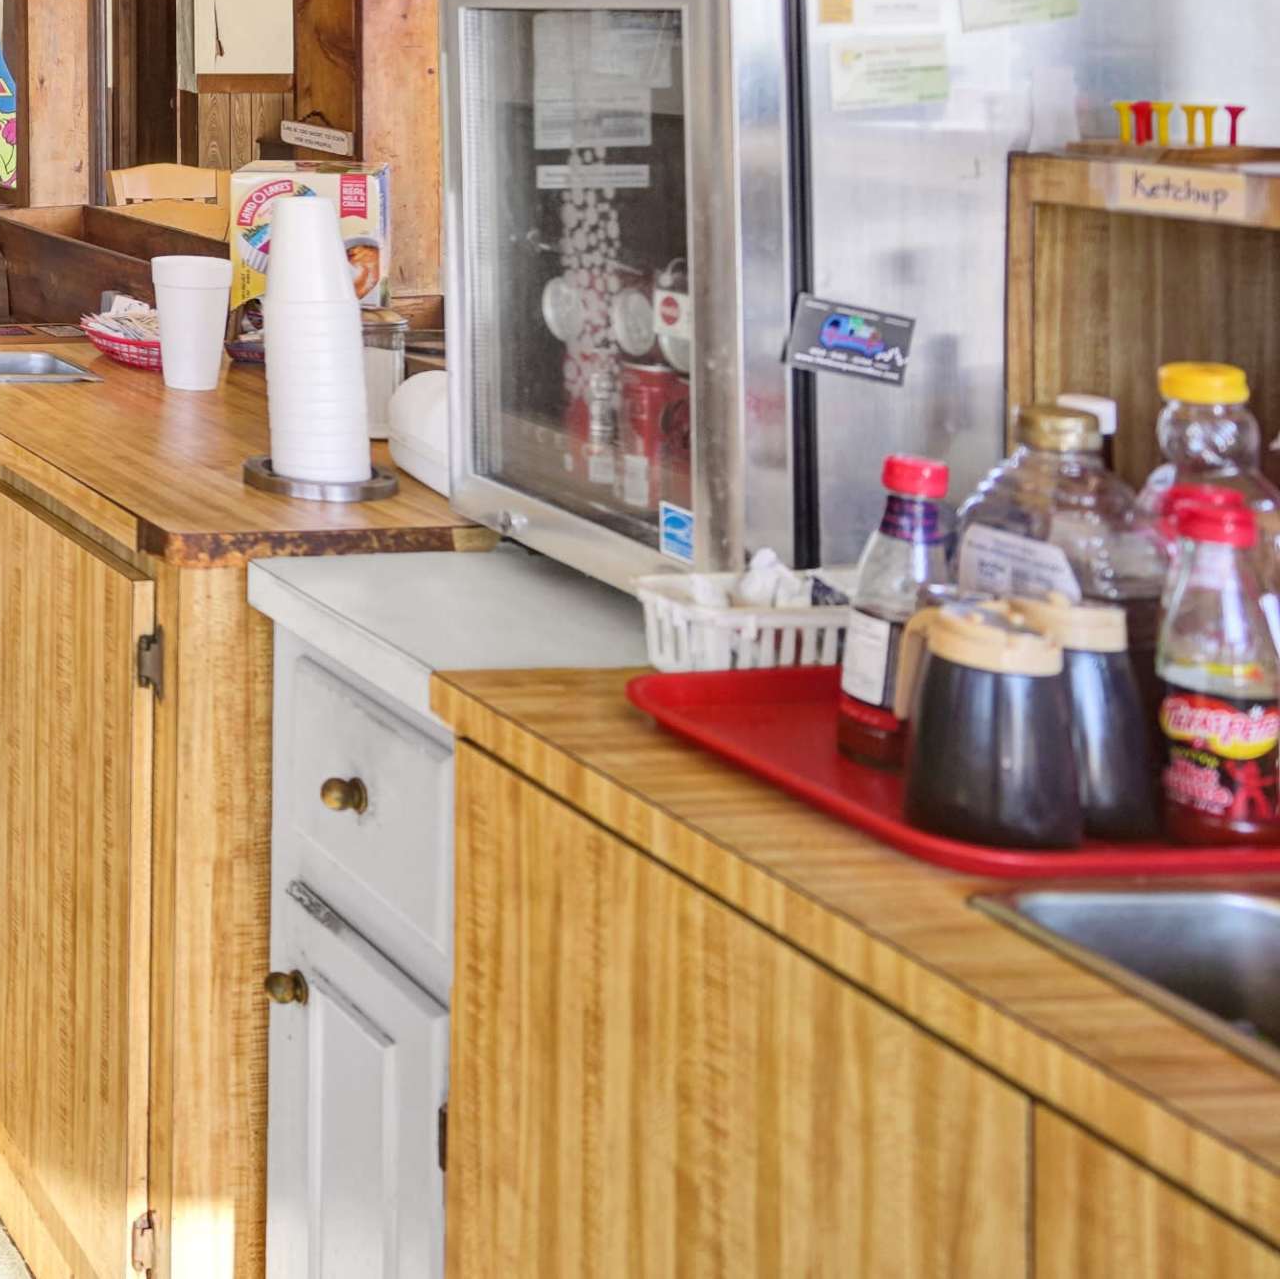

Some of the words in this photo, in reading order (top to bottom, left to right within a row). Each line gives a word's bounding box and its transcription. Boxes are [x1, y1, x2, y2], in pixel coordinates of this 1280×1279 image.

[239, 201, 257, 223] LAND
[262, 181, 292, 197] LAKES
[1131, 168, 1230, 212] Ketchup
